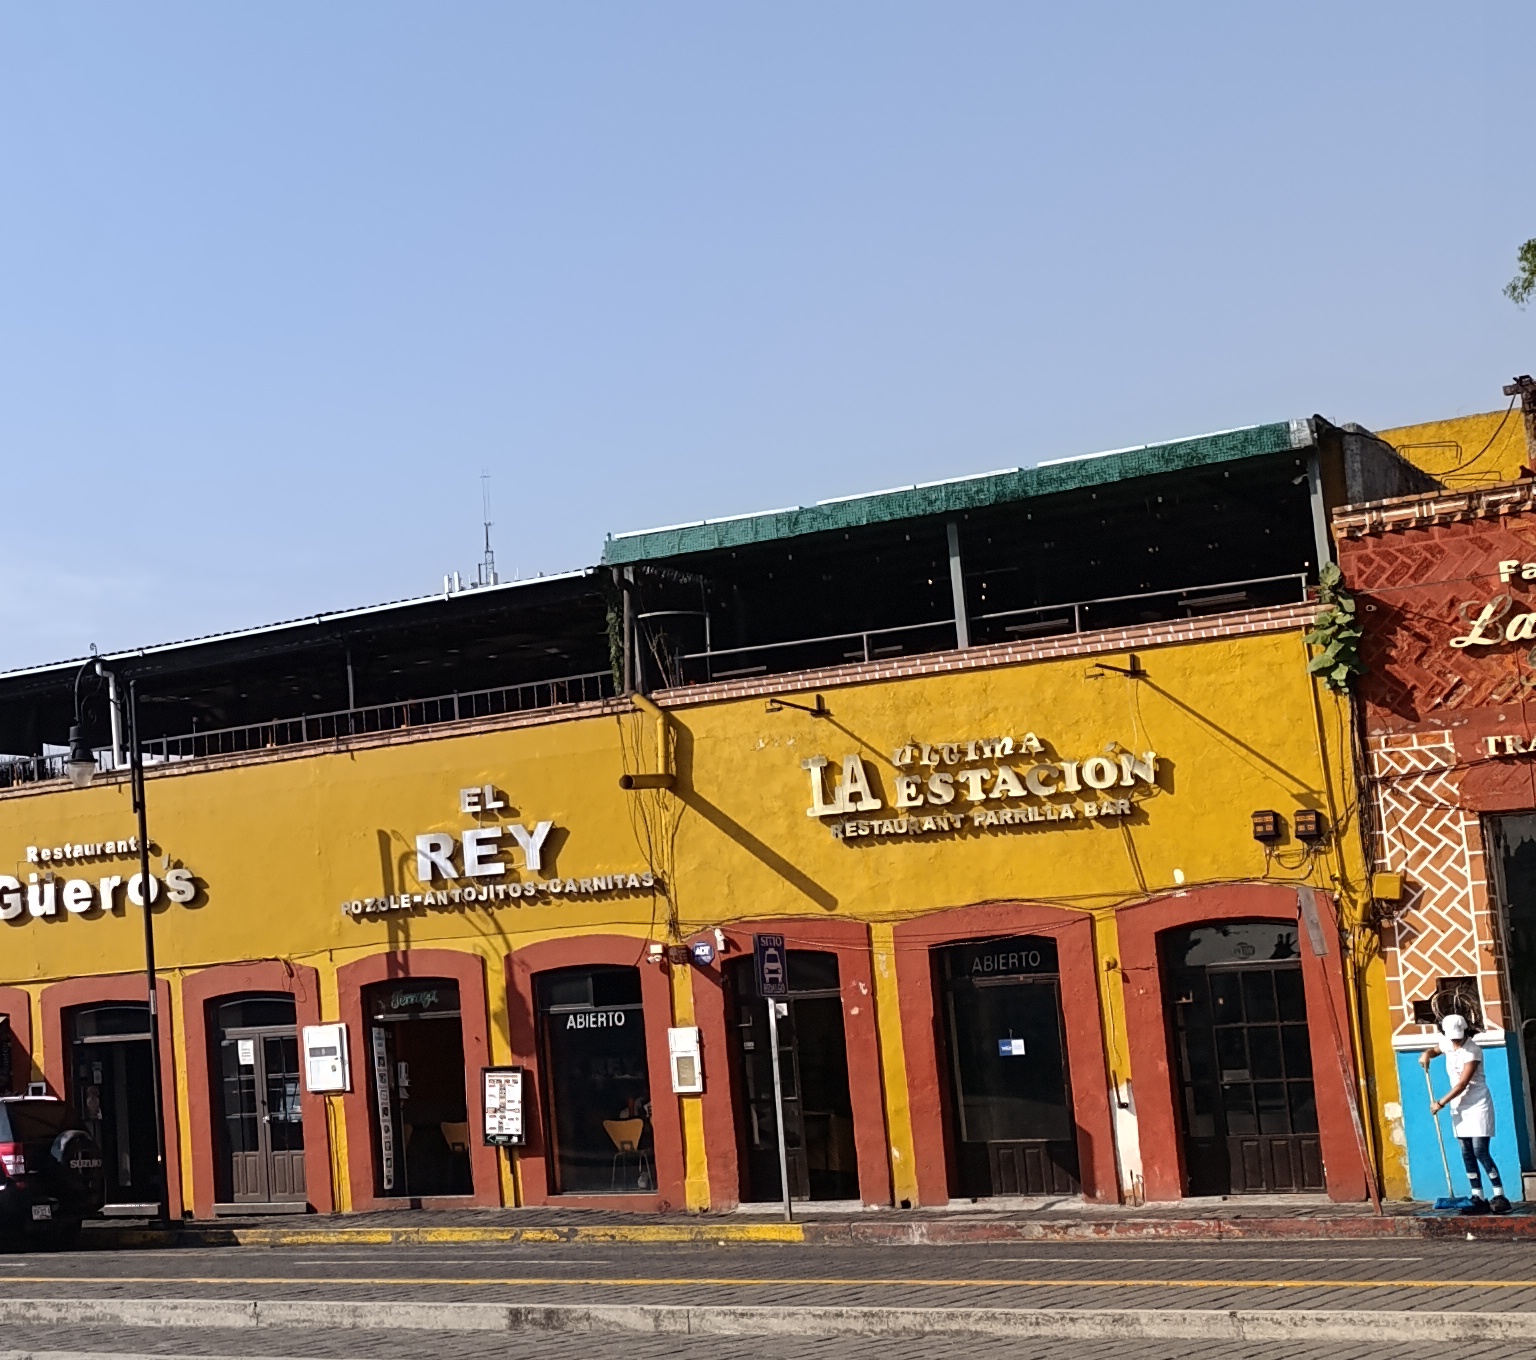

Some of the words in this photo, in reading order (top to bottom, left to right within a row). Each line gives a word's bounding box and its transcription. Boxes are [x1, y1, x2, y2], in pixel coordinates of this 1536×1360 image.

[802, 754, 881, 817] LA
[895, 741, 1157, 809] ESTACIÓN
[460, 785, 504, 813] EL
[831, 813, 965, 839] RESTAURANT
[974, 805, 1075, 827] PARRILLA
[1084, 797, 1132, 816] BAR
[416, 821, 555, 882] REY
[760, 936, 782, 947] SITIO
[972, 950, 1041, 973] ABIERTO
[566, 1011, 625, 1030] ABIERTO
[70, 1160, 102, 1169] SUZUKI
